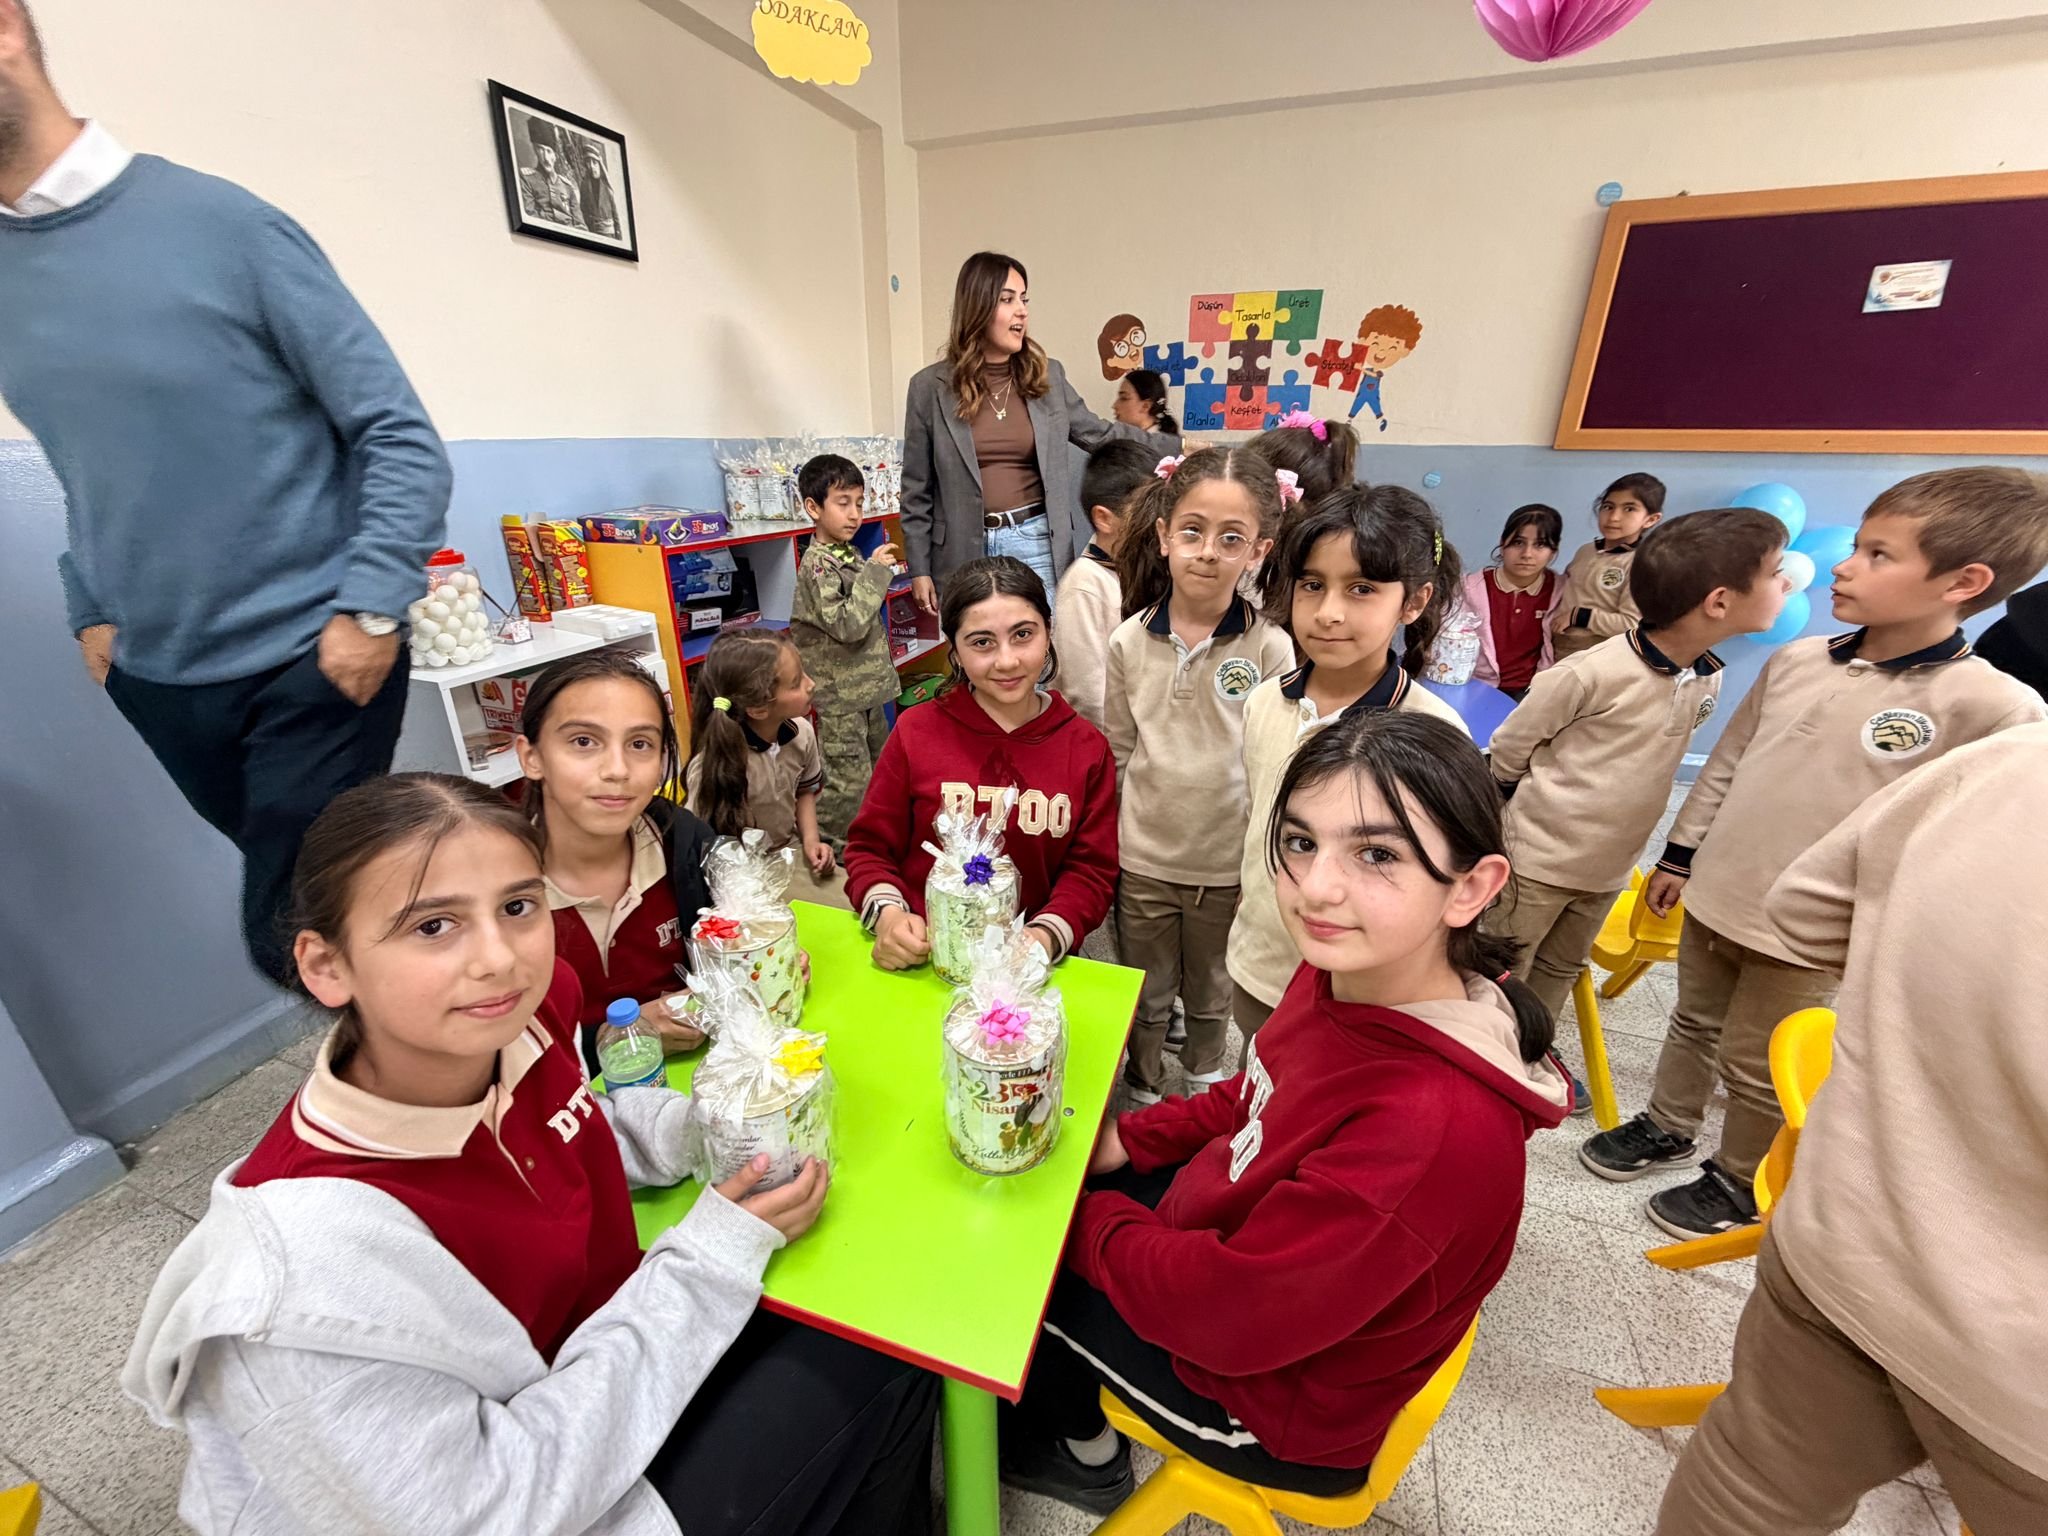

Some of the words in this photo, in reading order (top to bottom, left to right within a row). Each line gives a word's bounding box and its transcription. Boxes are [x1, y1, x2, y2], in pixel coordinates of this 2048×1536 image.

[759, 0, 863, 39] ODAKLAN
[1235, 308, 1271, 322] Tasarla
[1186, 410, 1217, 427] Planla
